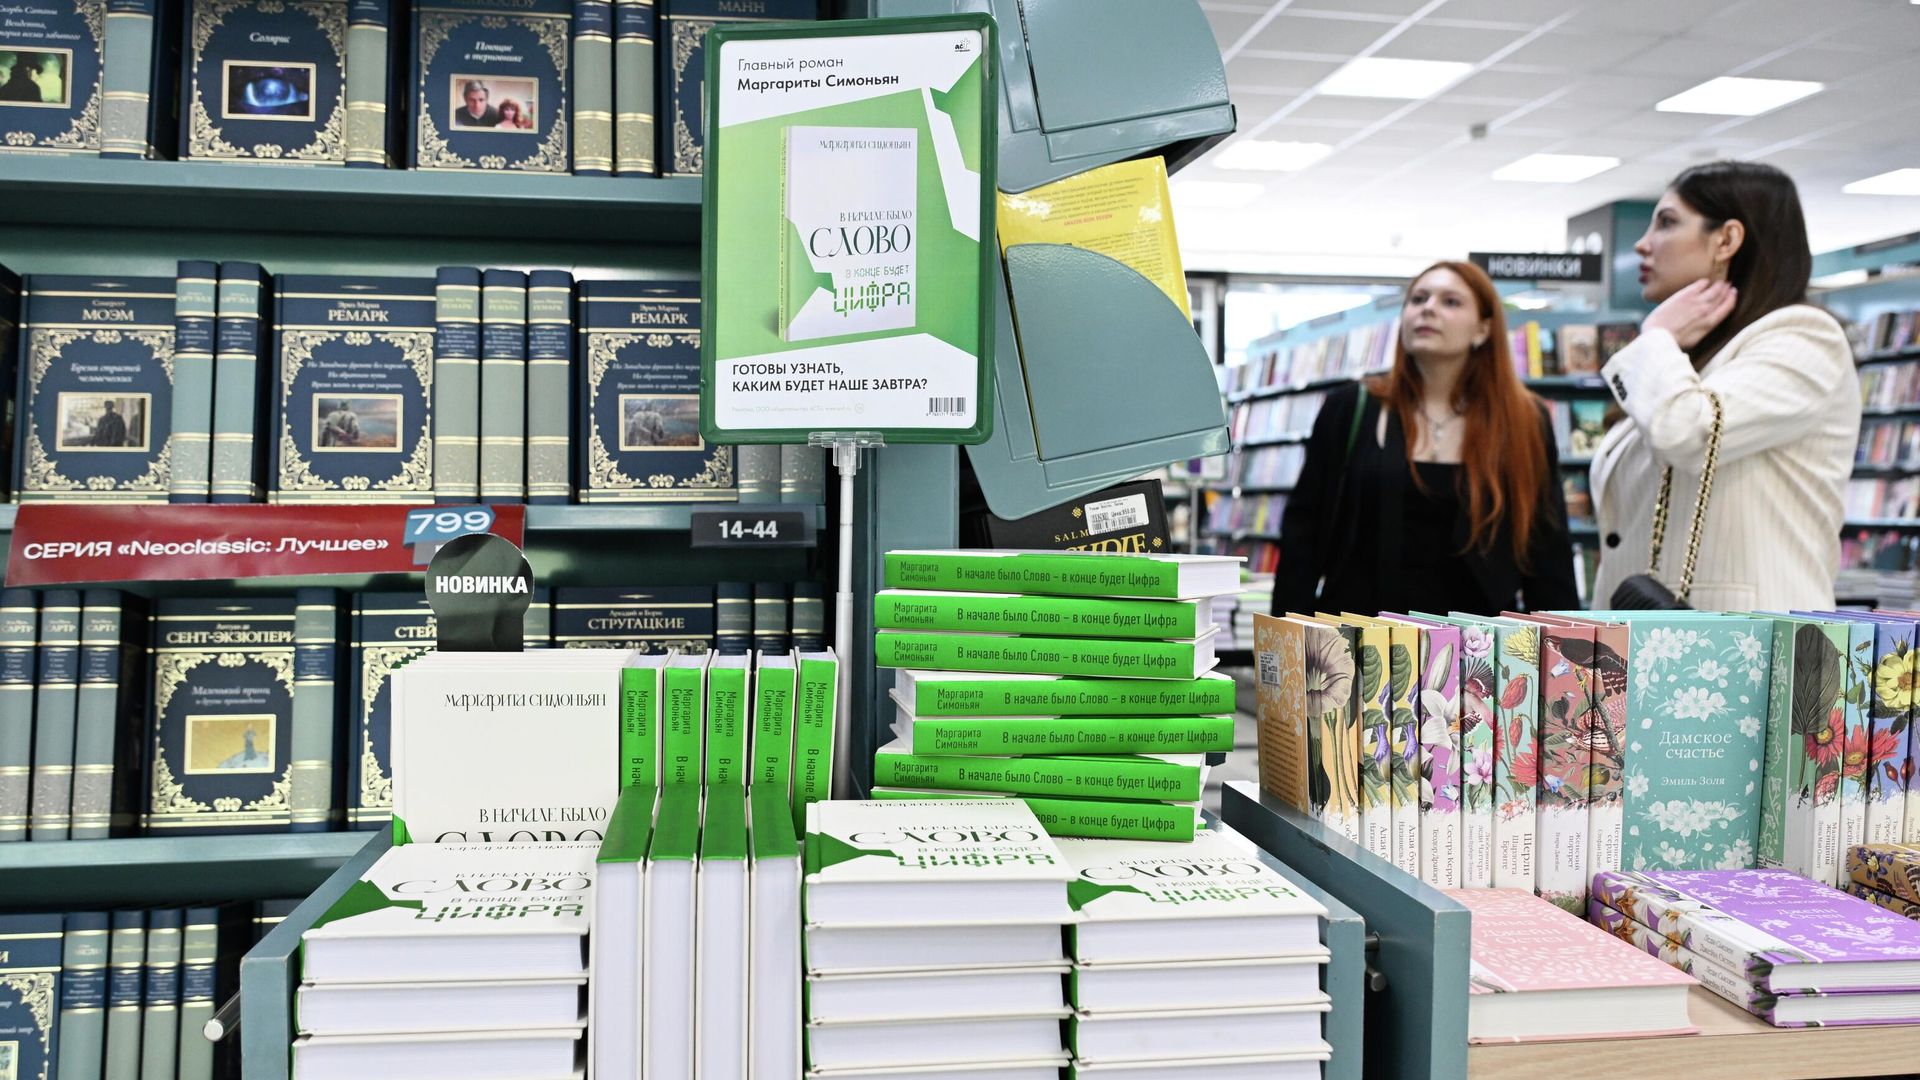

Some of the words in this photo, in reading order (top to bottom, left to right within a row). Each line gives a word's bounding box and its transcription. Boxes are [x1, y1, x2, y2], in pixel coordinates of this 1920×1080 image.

[738, 58, 794, 71] Главный
[800, 58, 844, 72] роман
[737, 76, 821, 93] Маргариты
[826, 74, 900, 87] Симоньян
[840, 212, 846, 222] В
[809, 224, 911, 258] СЛОВО
[845, 269, 851, 278] В
[854, 266, 881, 278] КОНЦЕ
[883, 264, 910, 276] БУДЕТ
[1487, 256, 1582, 277] НОВИНКИ
[833, 281, 911, 318] ЦИФРА
[82, 309, 134, 321] МОЭМ
[328, 309, 389, 322] РЕМАРК
[631, 312, 688, 324] РЕМАРК
[732, 364, 787, 375] ГОТОВЫ
[790, 363, 844, 375] УЗНАТЬ,
[732, 381, 781, 392] КАКИМ
[785, 380, 825, 392] БУДЕТ
[828, 379, 869, 391] НАШЕ
[872, 379, 928, 391] ЗАВТРА?
[409, 511, 491, 535] 799
[718, 520, 778, 539] 14-44
[1054, 528, 1090, 543] SALM
[24, 541, 112, 560] СЕРИЯ
[118, 538, 272, 556] «Neoclassic:
[276, 537, 389, 555] Лучшее»
[900, 561, 939, 573] Маргарита
[435, 575, 528, 594] НОВИНКА
[900, 573, 936, 582] Симоньян
[957, 567, 962, 579] В
[965, 568, 995, 580] начале
[997, 568, 1021, 580] было
[1023, 569, 1050, 582] Слово
[1062, 574, 1067, 582] в
[1070, 574, 1097, 585] конце
[1100, 572, 1125, 587] будет
[1128, 573, 1160, 588] Цифра
[894, 602, 938, 615] Маргарита
[588, 617, 685, 630] СТРУГАЦКИЕ
[894, 614, 934, 624] Симоньян
[957, 608, 964, 620] В
[967, 611, 1000, 621] начале
[1003, 609, 1028, 622] было
[1031, 610, 1060, 623] Слово
[1072, 614, 1078, 623] в
[1081, 615, 1110, 626] конце
[1113, 613, 1141, 627] будет
[1144, 614, 1177, 628] Цифра
[166, 631, 296, 644] СЕНТ-ЭКЗЮПЕРИ
[395, 626, 438, 639] СТЕЙ
[894, 640, 938, 652] Маргарита
[894, 652, 934, 662] Симоньян
[957, 647, 964, 658] В
[966, 649, 1000, 660] начале
[1002, 648, 1028, 661] было
[1030, 649, 1060, 662] Слово
[1072, 653, 1078, 663] в
[1081, 654, 1109, 665] конце
[1112, 652, 1140, 667] будет
[1143, 653, 1176, 667] Цифра
[804, 681, 816, 724] Симоньян
[937, 689, 984, 700] Маргарита
[1004, 693, 1011, 704] В
[1014, 693, 1048, 704] начале
[1051, 693, 1077, 704] было
[1079, 693, 1109, 704] Слово
[1120, 695, 1126, 704] в
[1129, 695, 1157, 706] конце
[1160, 693, 1186, 706] будет
[1188, 692, 1220, 706] Цифра
[627, 690, 637, 733] Симоньян
[672, 688, 682, 731] Симоньян
[683, 688, 694, 735] Маргарита
[715, 691, 725, 734] Симоньян
[763, 689, 774, 732] Симоньян
[774, 690, 785, 736] Маргарита
[816, 682, 827, 728] Маргарита
[937, 700, 980, 710] Симоньян
[638, 690, 648, 737] Маргарита
[726, 691, 737, 737] Маргарита
[935, 728, 982, 739] Маргарита
[1002, 732, 1009, 743] В
[1012, 732, 1046, 743] начале
[1049, 732, 1075, 743] было
[1077, 732, 1107, 743] Слово
[1118, 734, 1124, 742] в
[1127, 733, 1155, 744] конце
[1158, 732, 1184, 744] будет
[1187, 731, 1218, 744] Цифра
[1659, 731, 1732, 746] Дамское
[935, 740, 978, 749] Симоньян
[1665, 747, 1724, 760] счастье
[805, 758, 816, 792] начале
[894, 762, 938, 773] Маргарита
[894, 773, 935, 784] Симоньян
[959, 768, 965, 780] В
[968, 770, 1001, 782] начале
[1005, 770, 1031, 783] было
[1033, 772, 1063, 785] Слово
[1076, 776, 1081, 785] в
[1085, 776, 1113, 787] конце
[1117, 775, 1144, 789] будет
[1148, 776, 1181, 792] Цифра
[1661, 777, 1697, 786] Эмиль
[1699, 776, 1725, 786] Золя
[480, 808, 489, 822] В
[1071, 816, 1076, 825] в
[1079, 815, 1108, 827] конце
[1111, 815, 1138, 829] будет
[1142, 816, 1175, 831] Цифра
[849, 831, 1038, 844] СЛОВО
[1446, 823, 1454, 856] Сестра
[1510, 835, 1519, 875] Шарлотта
[1521, 833, 1532, 876] Шерли
[1566, 836, 1574, 868] портрет
[1574, 832, 1582, 871] Женский
[1604, 834, 1612, 863] сердца
[899, 853, 1055, 869] ЦИФРА
[1080, 863, 1261, 880] СЛОВО
[1446, 857, 1454, 886] Керри
[392, 878, 592, 893] СЛОВО
[1143, 886, 1298, 905] ЦИФРА
[415, 904, 583, 922] ЦИФРА
